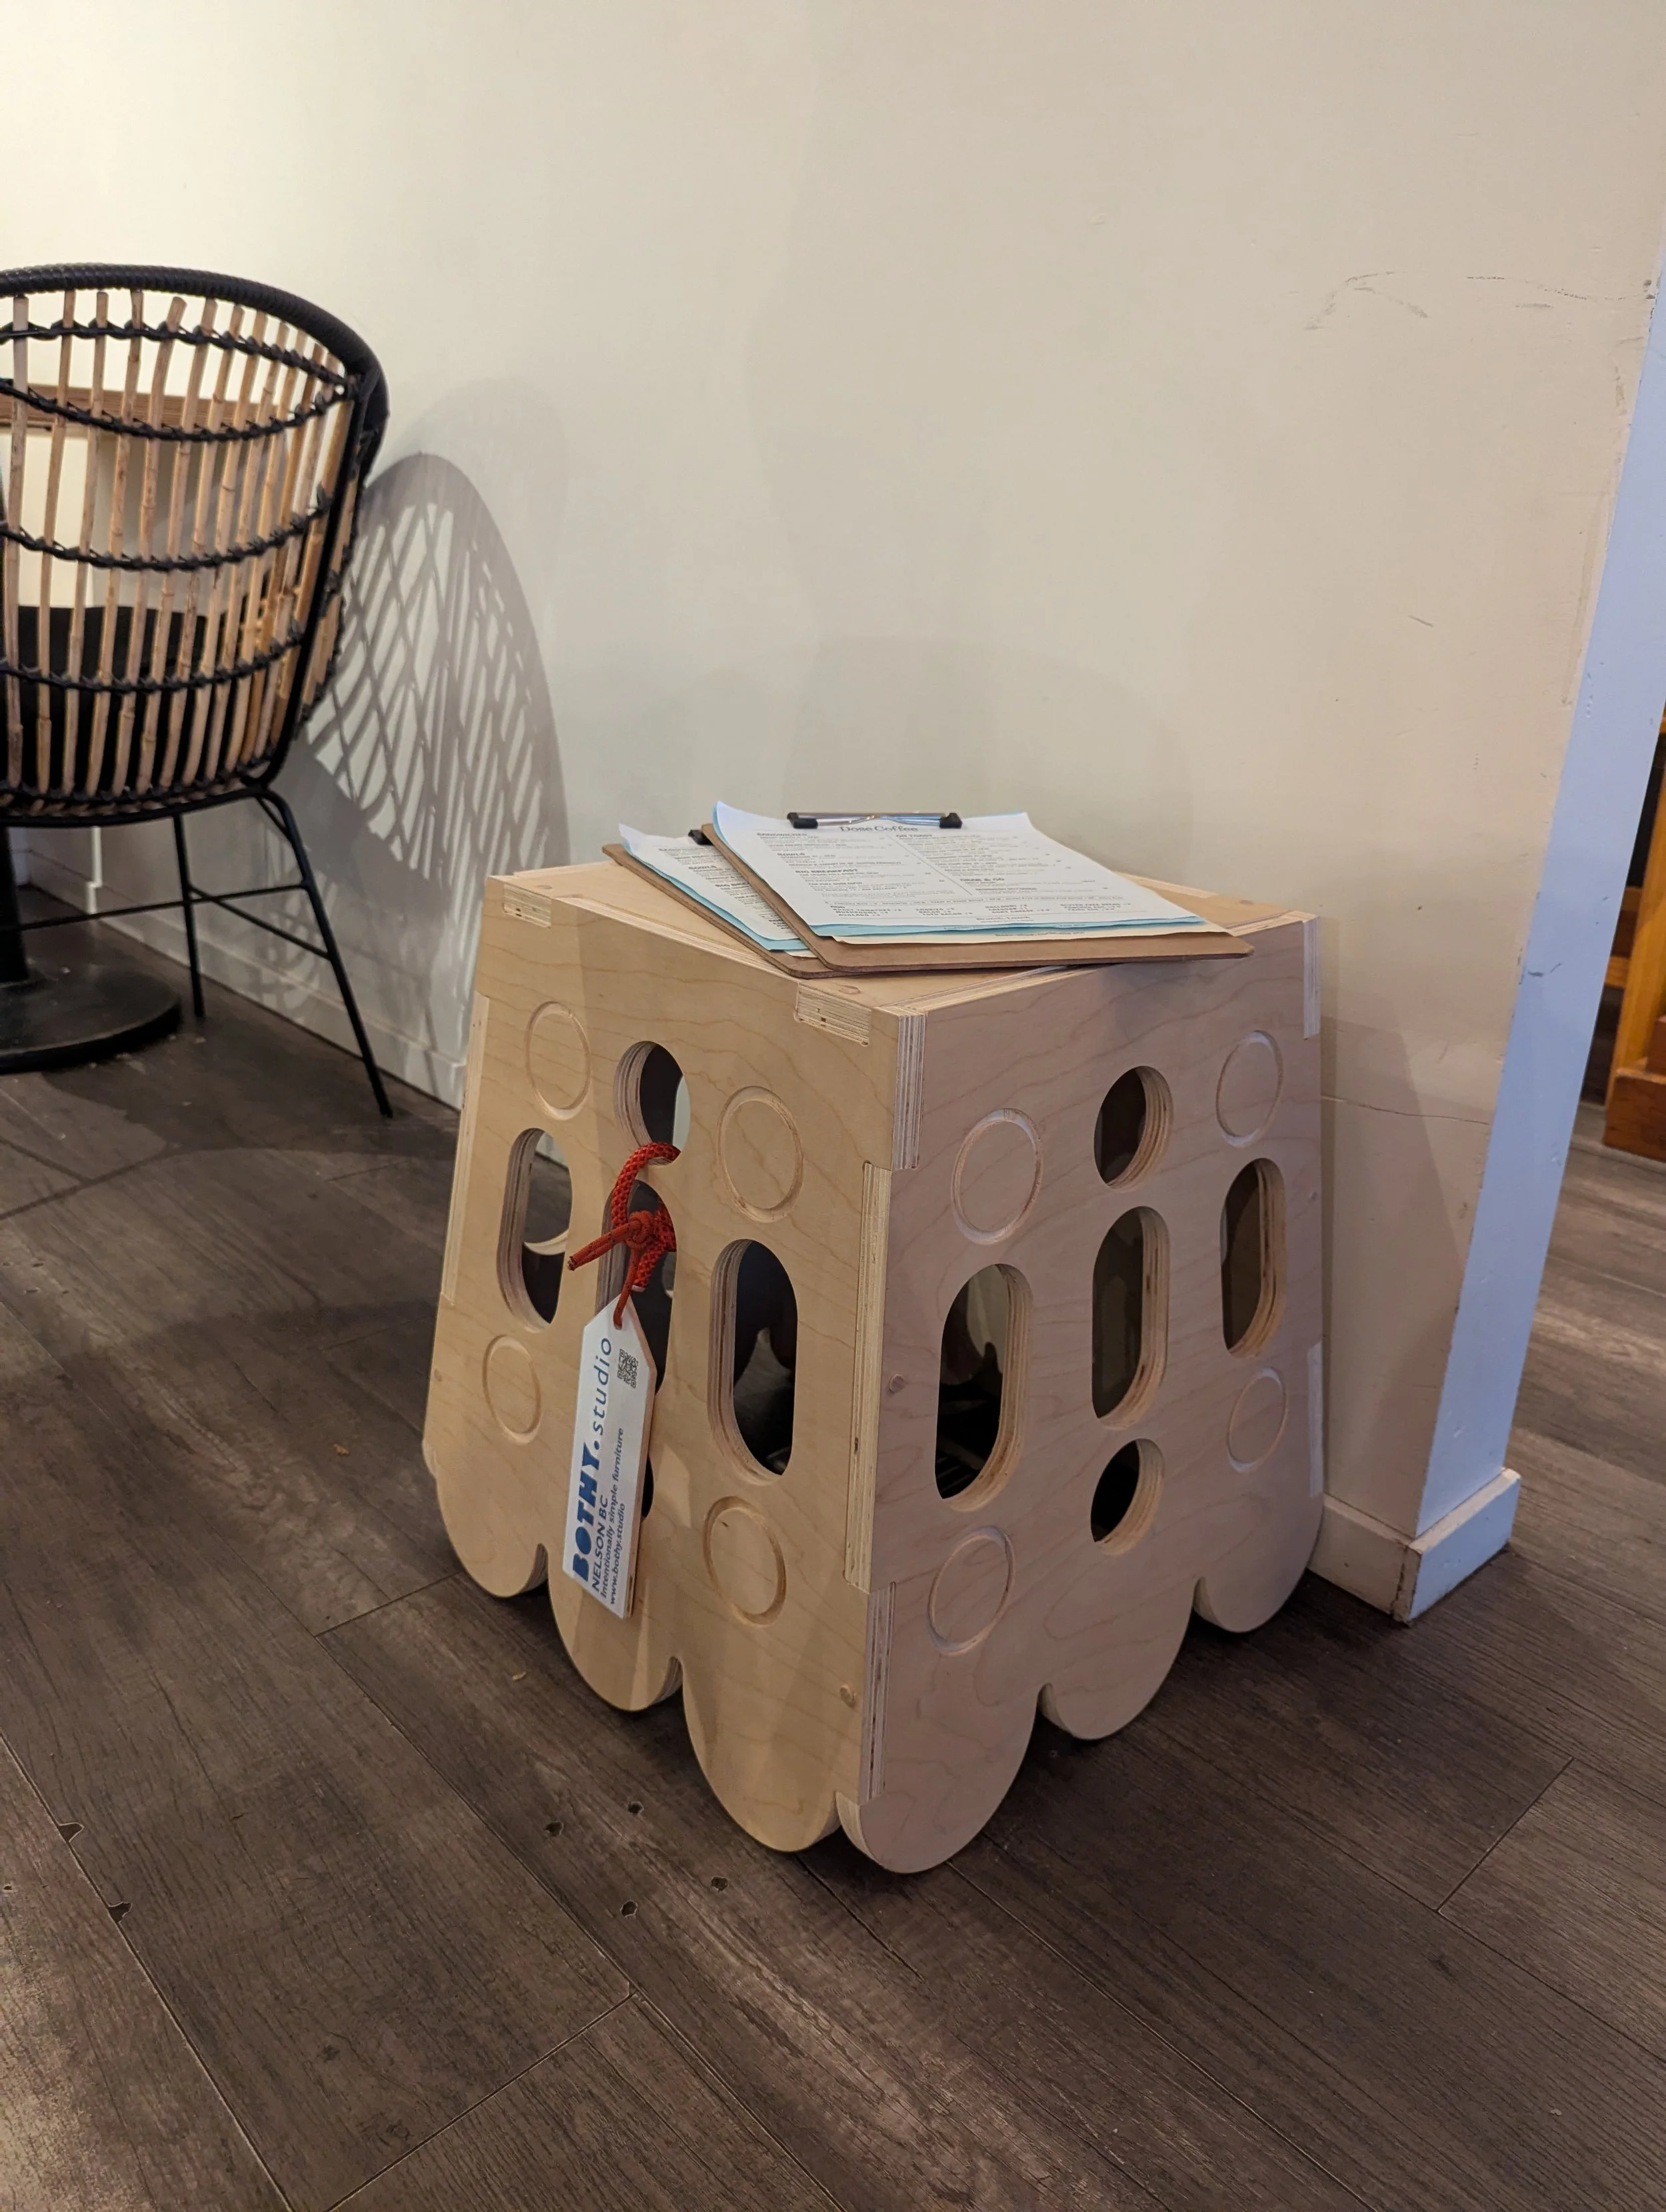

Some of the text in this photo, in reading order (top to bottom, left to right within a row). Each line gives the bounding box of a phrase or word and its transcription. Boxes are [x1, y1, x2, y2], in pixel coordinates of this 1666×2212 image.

[592, 1494, 608, 1592] NELSON BC
[600, 1427, 624, 1599] Intentionally simple furniture
[609, 1502, 626, 1605] www.bothy.studio
